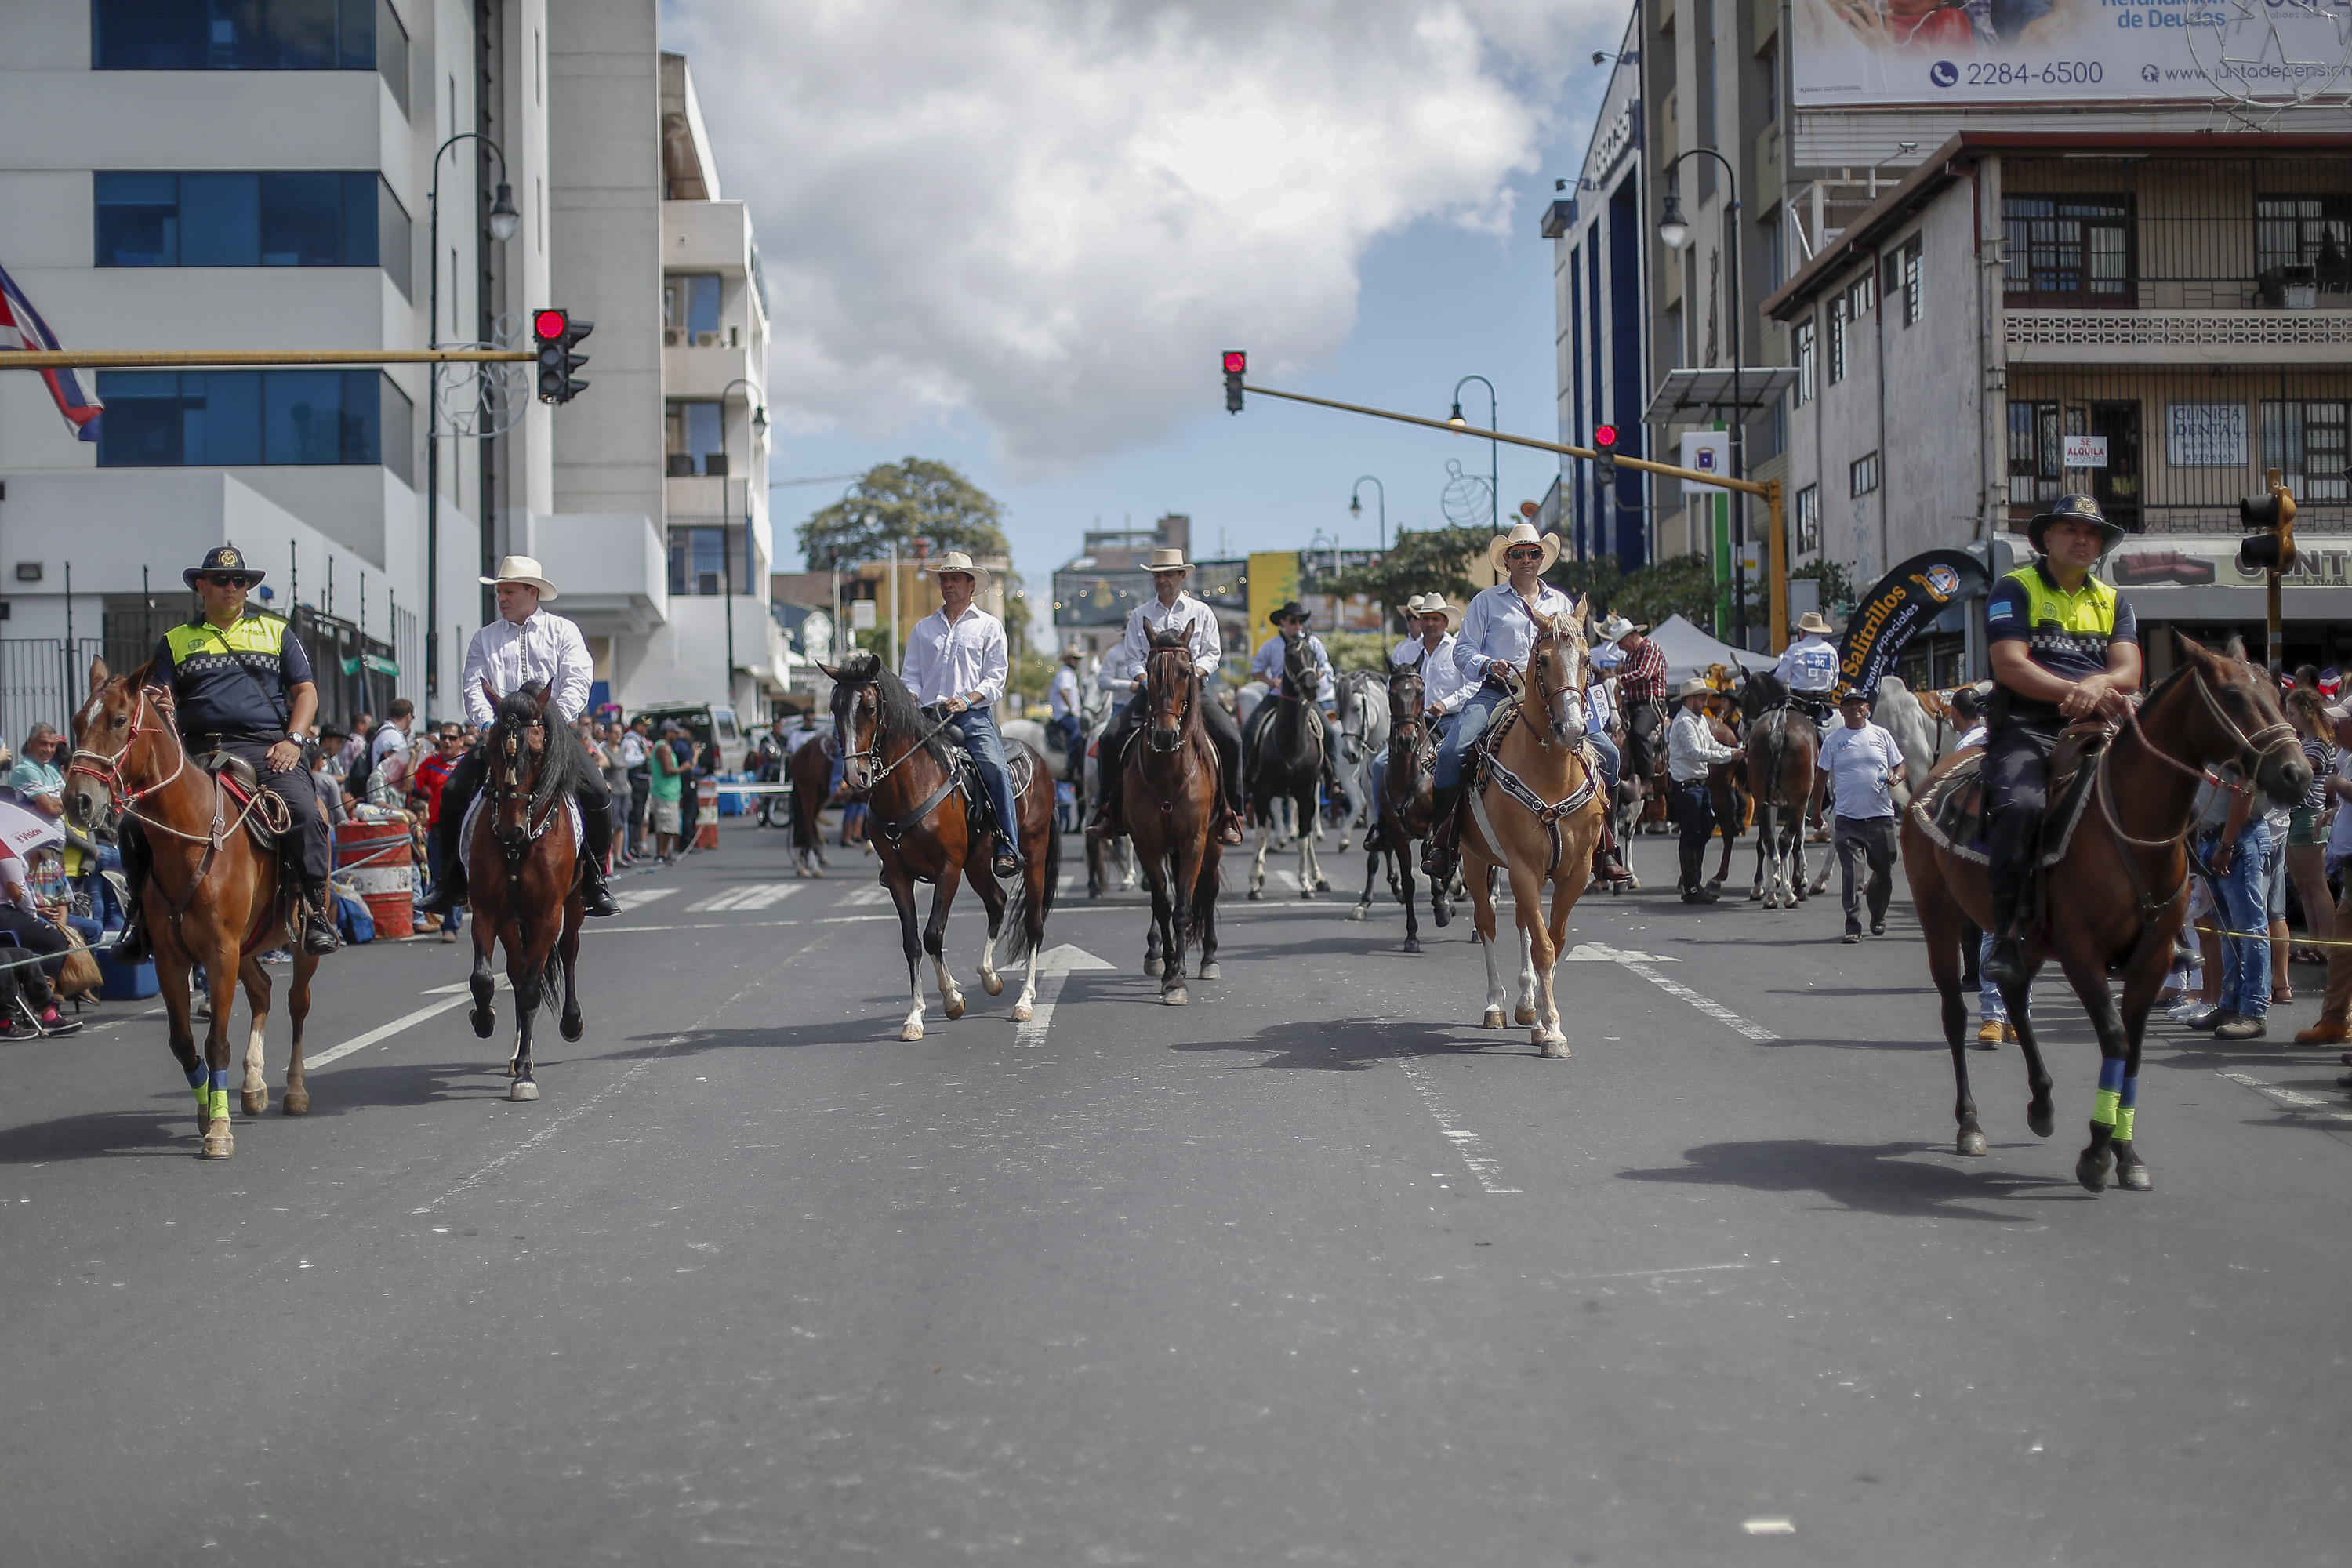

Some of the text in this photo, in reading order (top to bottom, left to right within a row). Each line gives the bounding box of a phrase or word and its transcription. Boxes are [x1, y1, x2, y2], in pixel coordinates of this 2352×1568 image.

[2118, 7, 2226, 28] de Deudas
[1968, 61, 2103, 84] 2284-6500
[2165, 63, 2352, 82] wwwjuntadepension
[2174, 423, 2241, 435] DENTAL
[2067, 447, 2104, 456] ALQUILA
[2080, 437, 2091, 446] SE
[2235, 549, 2352, 577] CNT
[1842, 586, 1907, 677] Salitrillos
